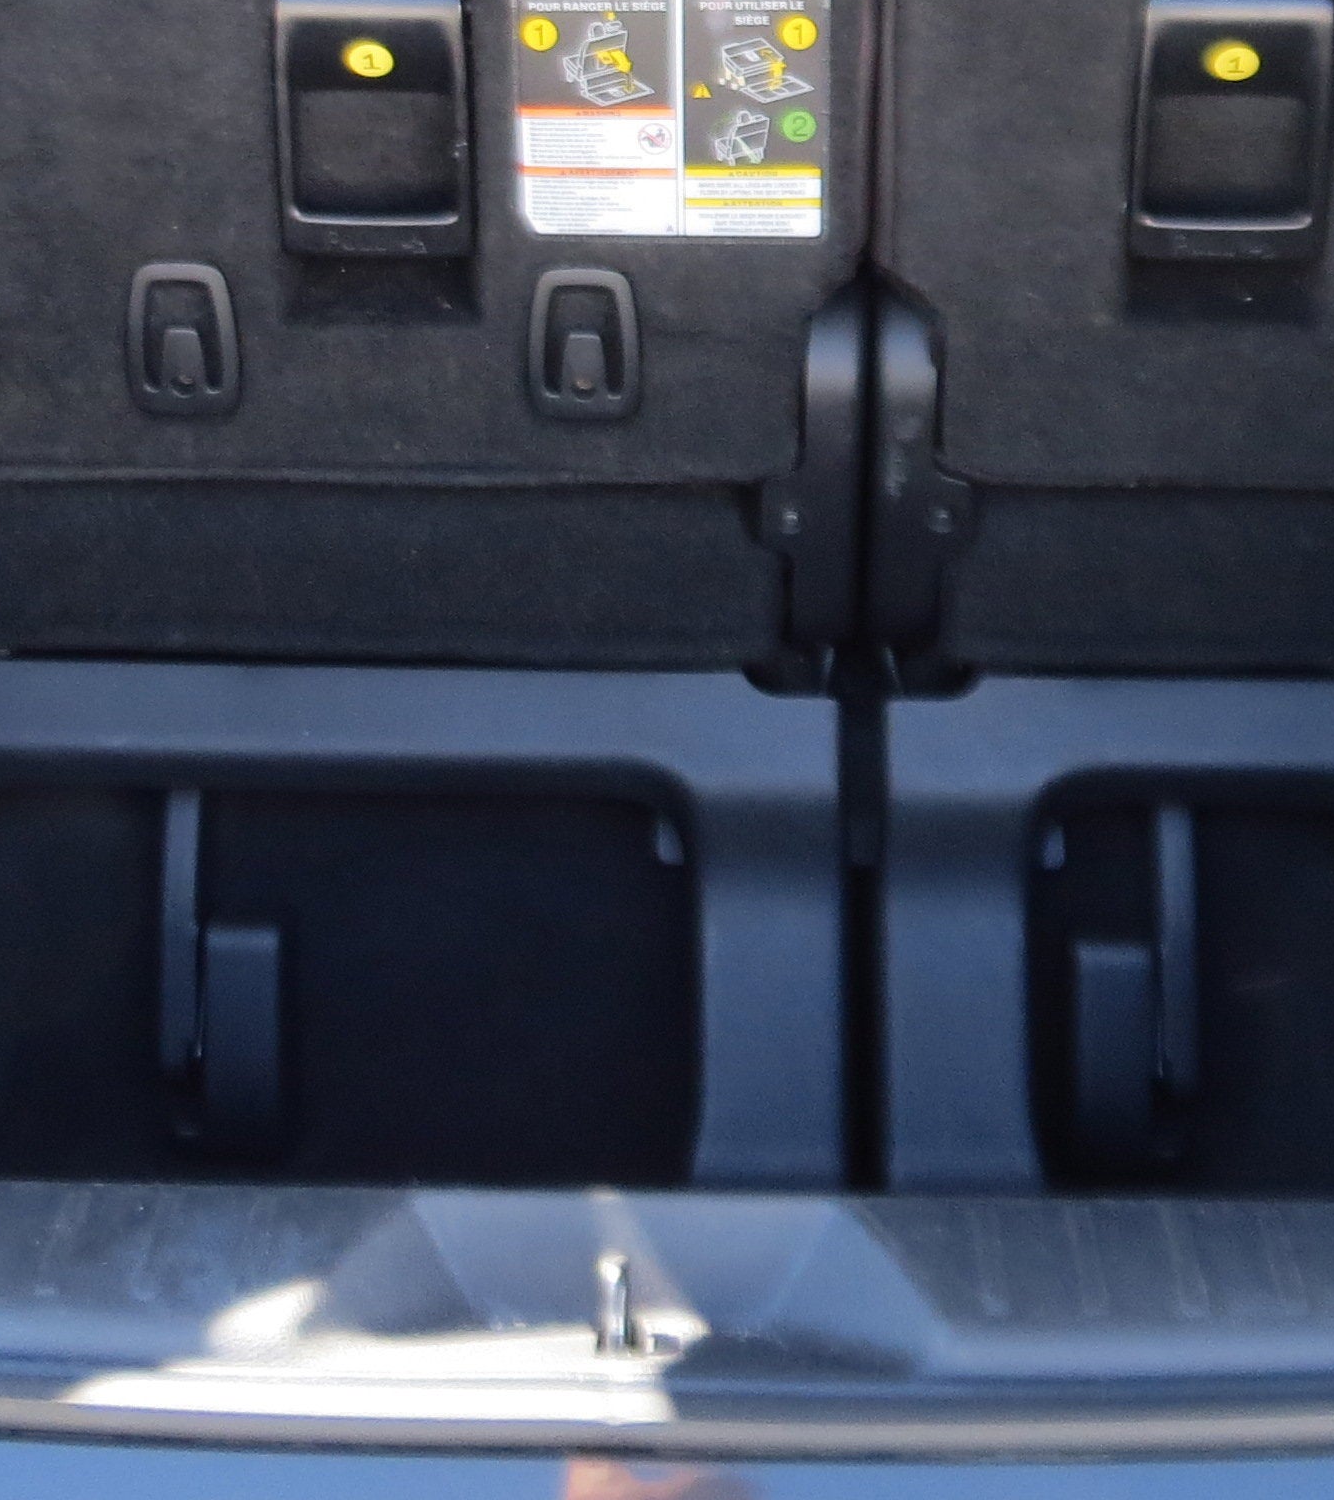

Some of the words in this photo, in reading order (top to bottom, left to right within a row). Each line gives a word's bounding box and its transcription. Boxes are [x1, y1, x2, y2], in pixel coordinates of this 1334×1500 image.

[528, 2, 561, 12] POUR
[562, 2, 612, 12] RANGER
[615, 2, 629, 12] LE
[699, 1, 733, 11] POUR
[735, 1, 788, 11] UTILISER
[789, 1, 805, 11] LE
[534, 24, 544, 46] 1
[793, 24, 803, 45] 1
[362, 53, 381, 70] 1
[1227, 56, 1245, 73] 1
[792, 116, 808, 137] 2
